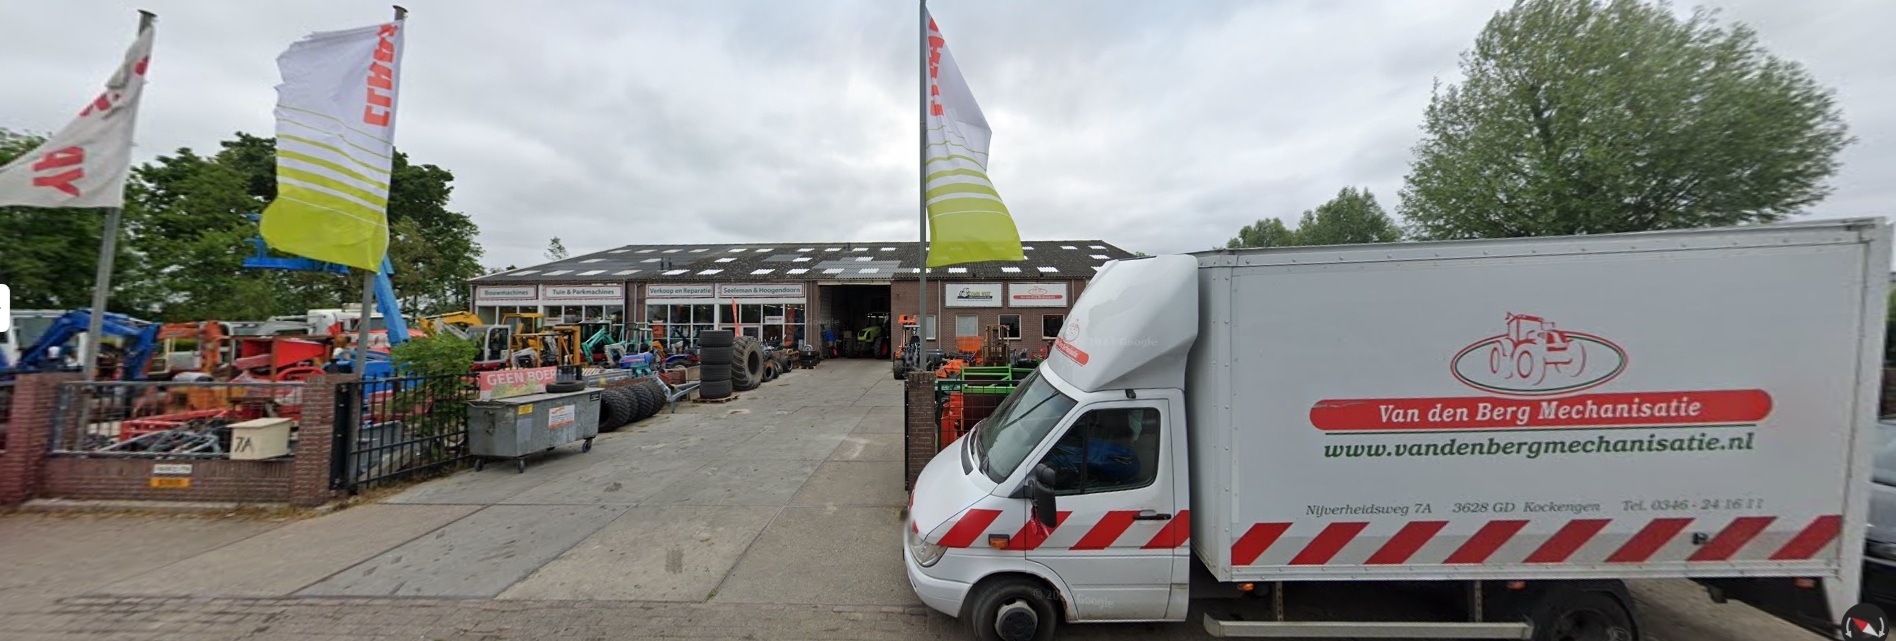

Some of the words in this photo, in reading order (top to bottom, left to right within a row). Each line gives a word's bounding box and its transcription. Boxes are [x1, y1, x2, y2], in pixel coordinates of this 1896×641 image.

[572, 288, 614, 296] Parkmachines
[487, 370, 524, 386] GEEN
[1378, 404, 1419, 423] Van
[1428, 403, 1468, 422] den
[1475, 402, 1530, 425] Berg
[1538, 398, 1701, 419] Mechanisatie
[235, 436, 253, 453] 7A
[1323, 432, 1755, 459] www.vandenbergmechanisatie.nl
[1306, 503, 1408, 518] Nijverheidsweg
[1414, 503, 1433, 514] 7A
[1452, 502, 1489, 514] 3628
[1492, 502, 1516, 513] GD
[1523, 501, 1601, 516] Kockengen
[1650, 499, 1690, 511] 0346
[1700, 499, 1720, 510] 24
[1724, 498, 1742, 510] 16
